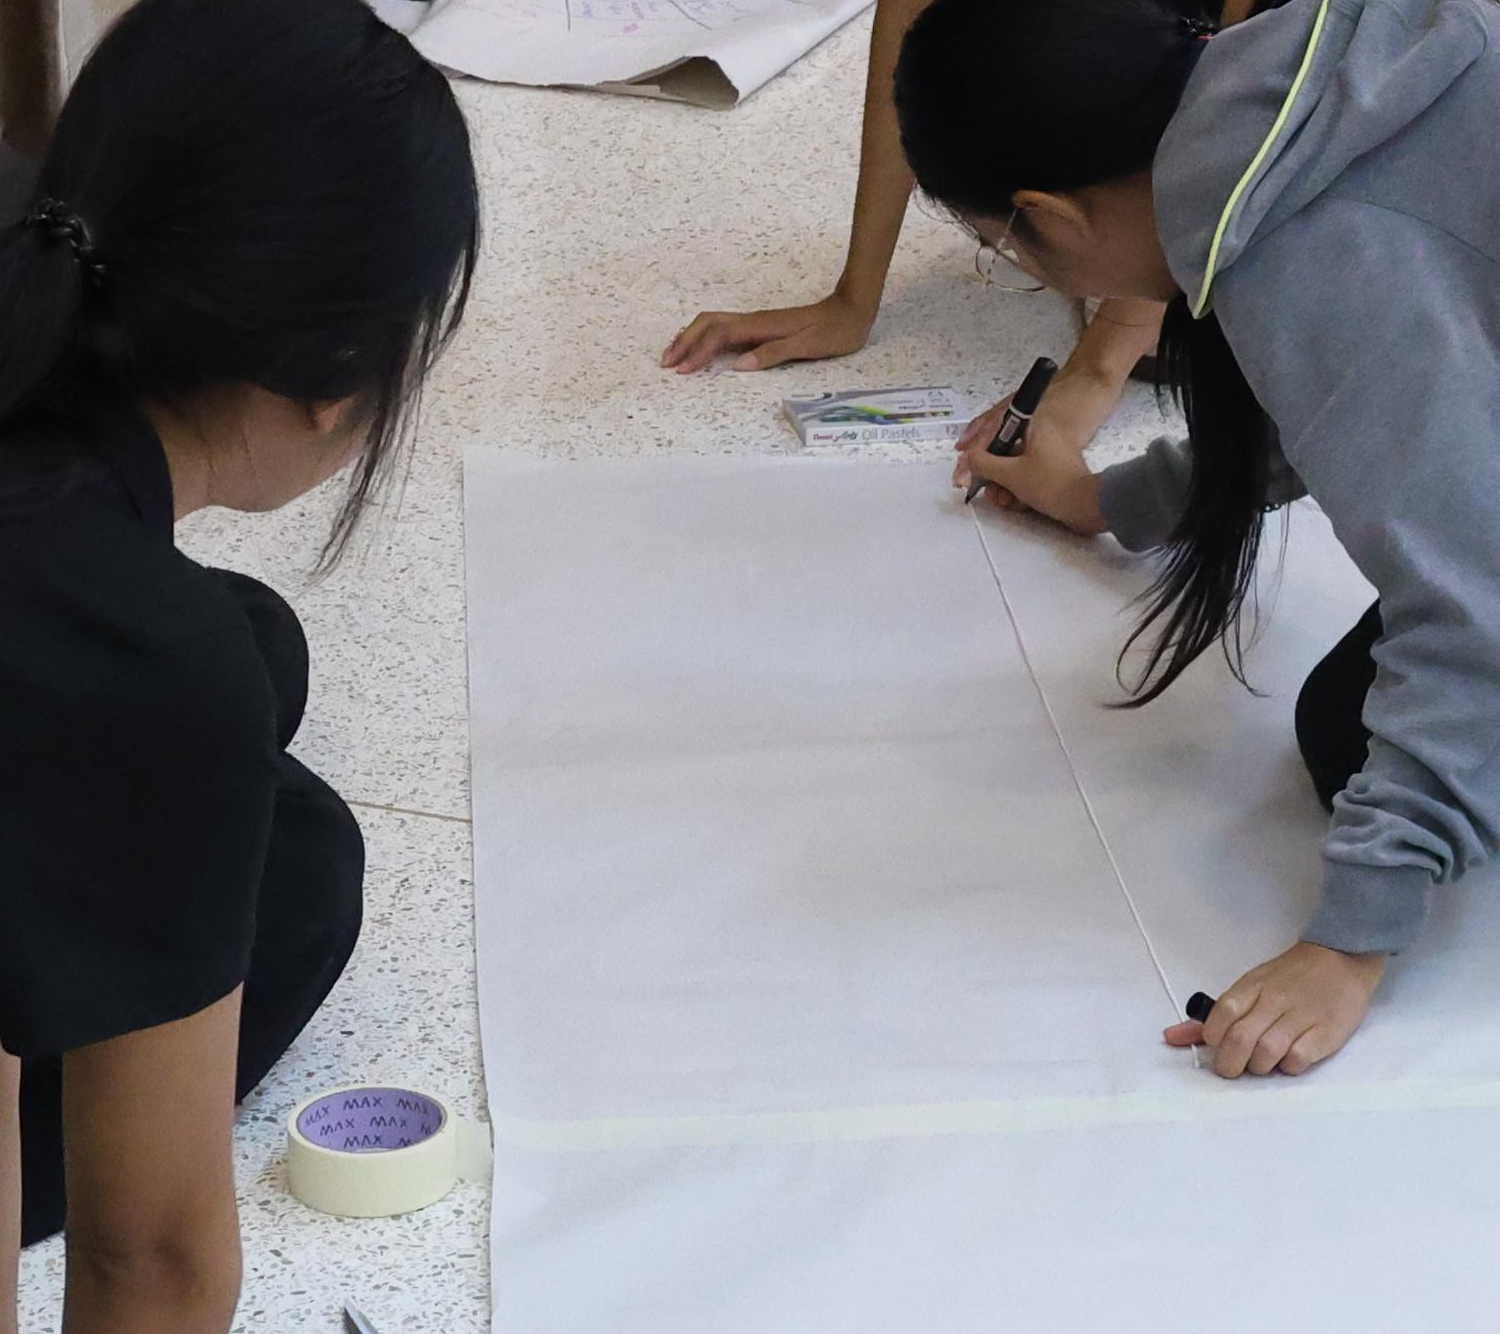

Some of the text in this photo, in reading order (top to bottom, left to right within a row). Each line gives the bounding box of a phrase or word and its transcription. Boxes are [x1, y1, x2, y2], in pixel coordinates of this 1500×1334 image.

[861, 428, 879, 441] Oil
[881, 426, 921, 440] Pastels
[343, 1096, 383, 1111] MAX
[319, 1115, 409, 1137] MAX MAX
[343, 1134, 384, 1149] MAX
